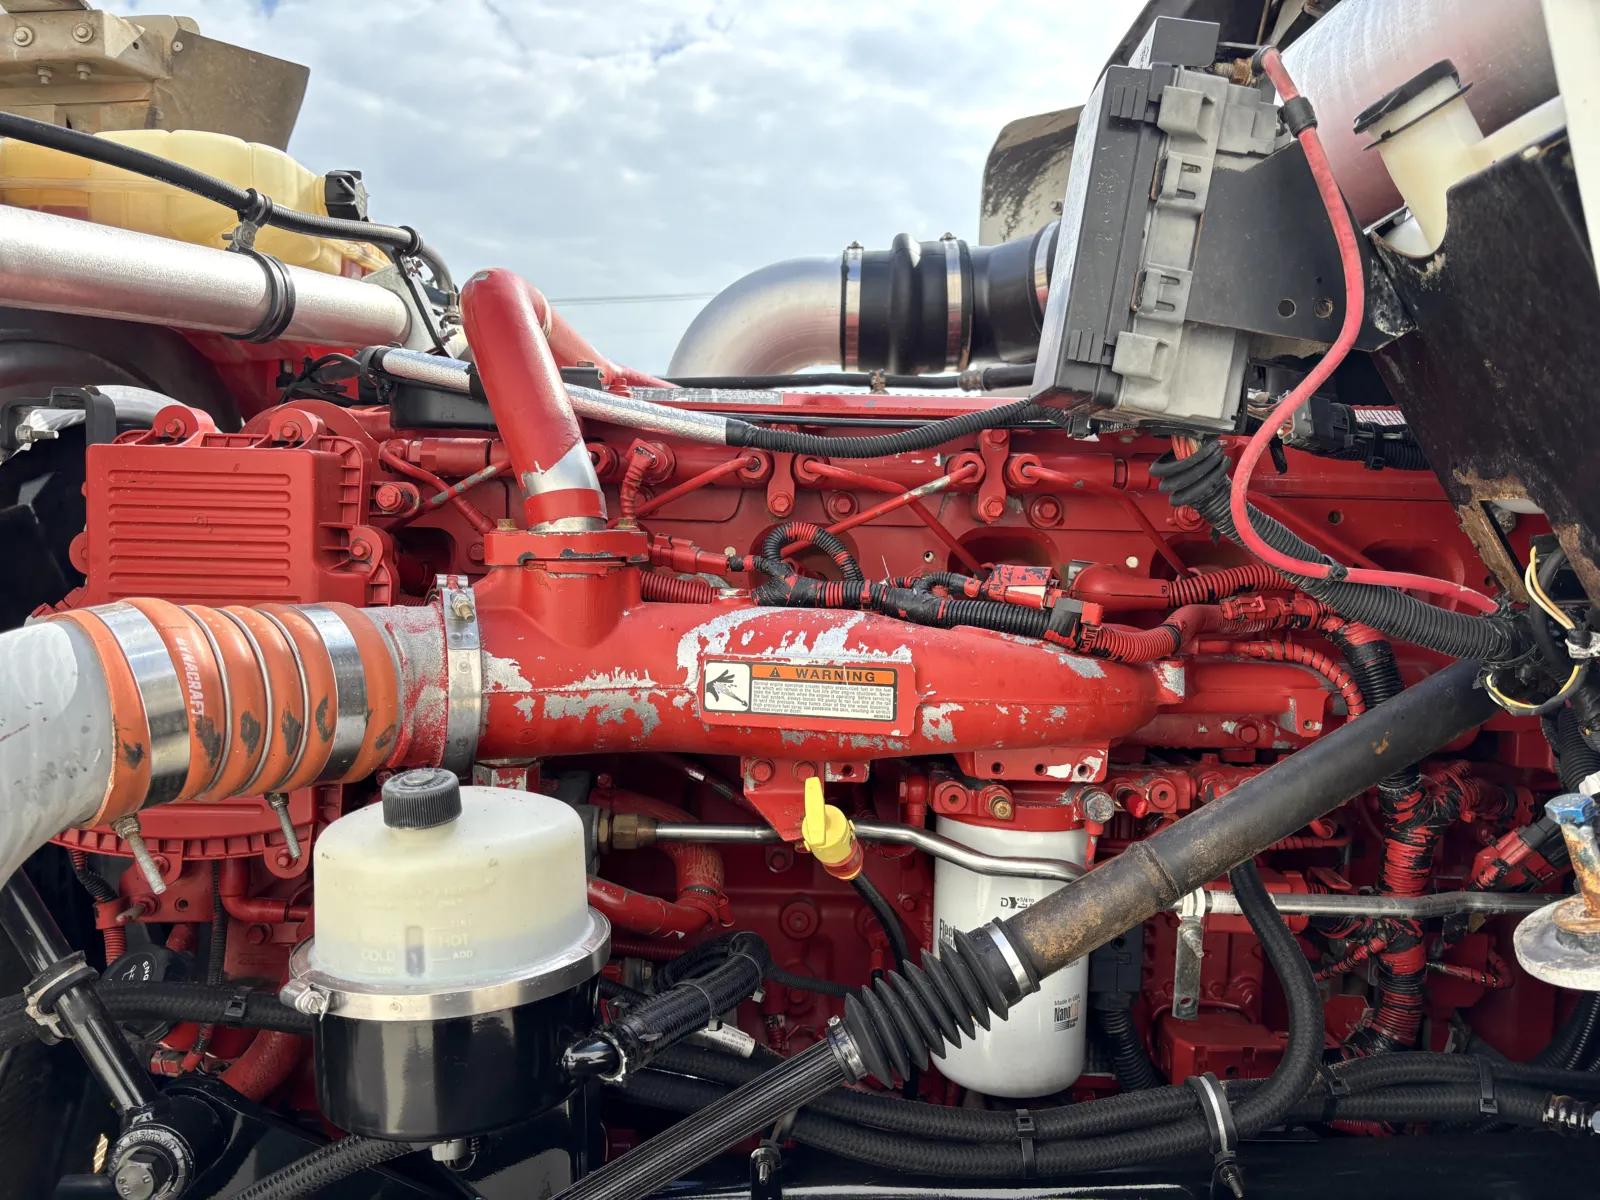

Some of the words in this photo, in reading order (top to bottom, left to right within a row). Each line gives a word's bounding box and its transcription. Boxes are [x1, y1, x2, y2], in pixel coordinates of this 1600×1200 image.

[176, 636, 205, 717] DYNACRAFT
[795, 667, 876, 683] WARNING
[440, 933, 470, 948] HOT
[360, 949, 396, 962] COLD
[452, 950, 474, 961] ADD
